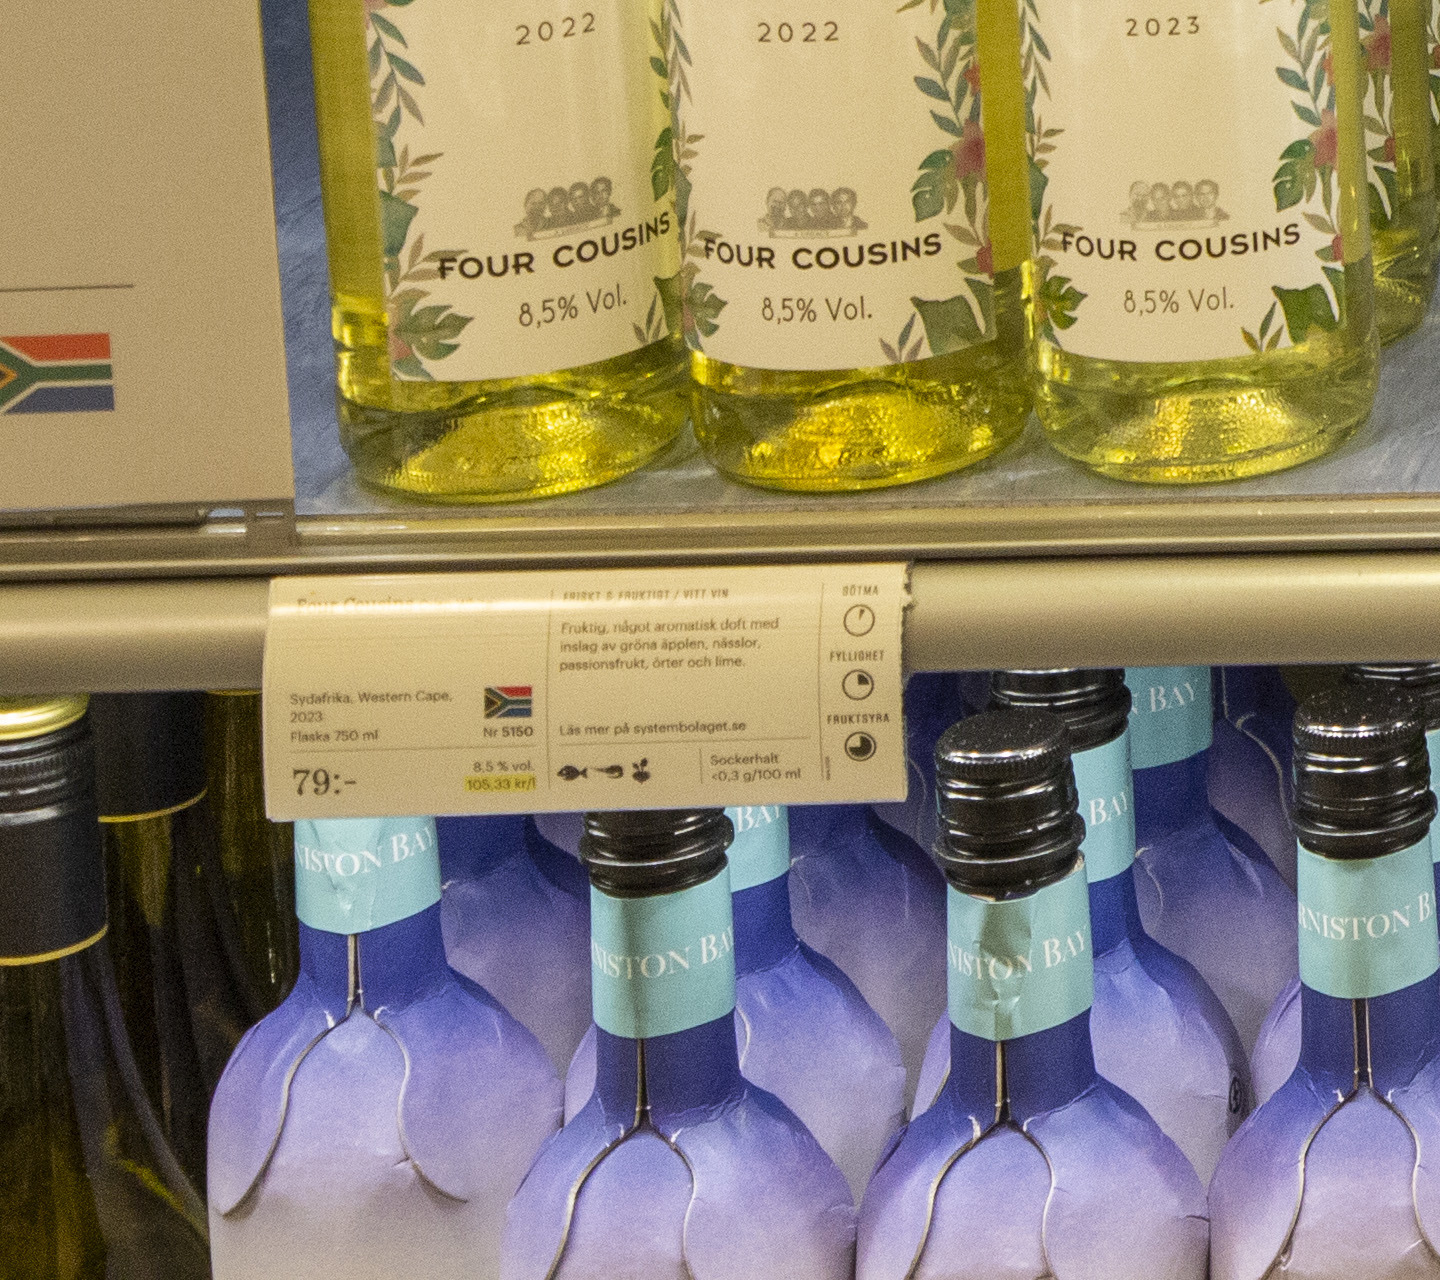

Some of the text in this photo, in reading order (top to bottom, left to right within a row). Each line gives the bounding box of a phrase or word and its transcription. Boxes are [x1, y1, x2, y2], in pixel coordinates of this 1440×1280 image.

[515, 12, 597, 46] 2022
[757, 20, 840, 42] 2022
[1125, 16, 1201, 38] 2023
[438, 213, 671, 282] FOUR COUSINS
[703, 232, 942, 271] FOUR COUSINS
[1060, 223, 1300, 265] FOUR COUSINS
[1123, 286, 1234, 317] 8,5% Vol.
[1042, 922, 1090, 966] BAY
